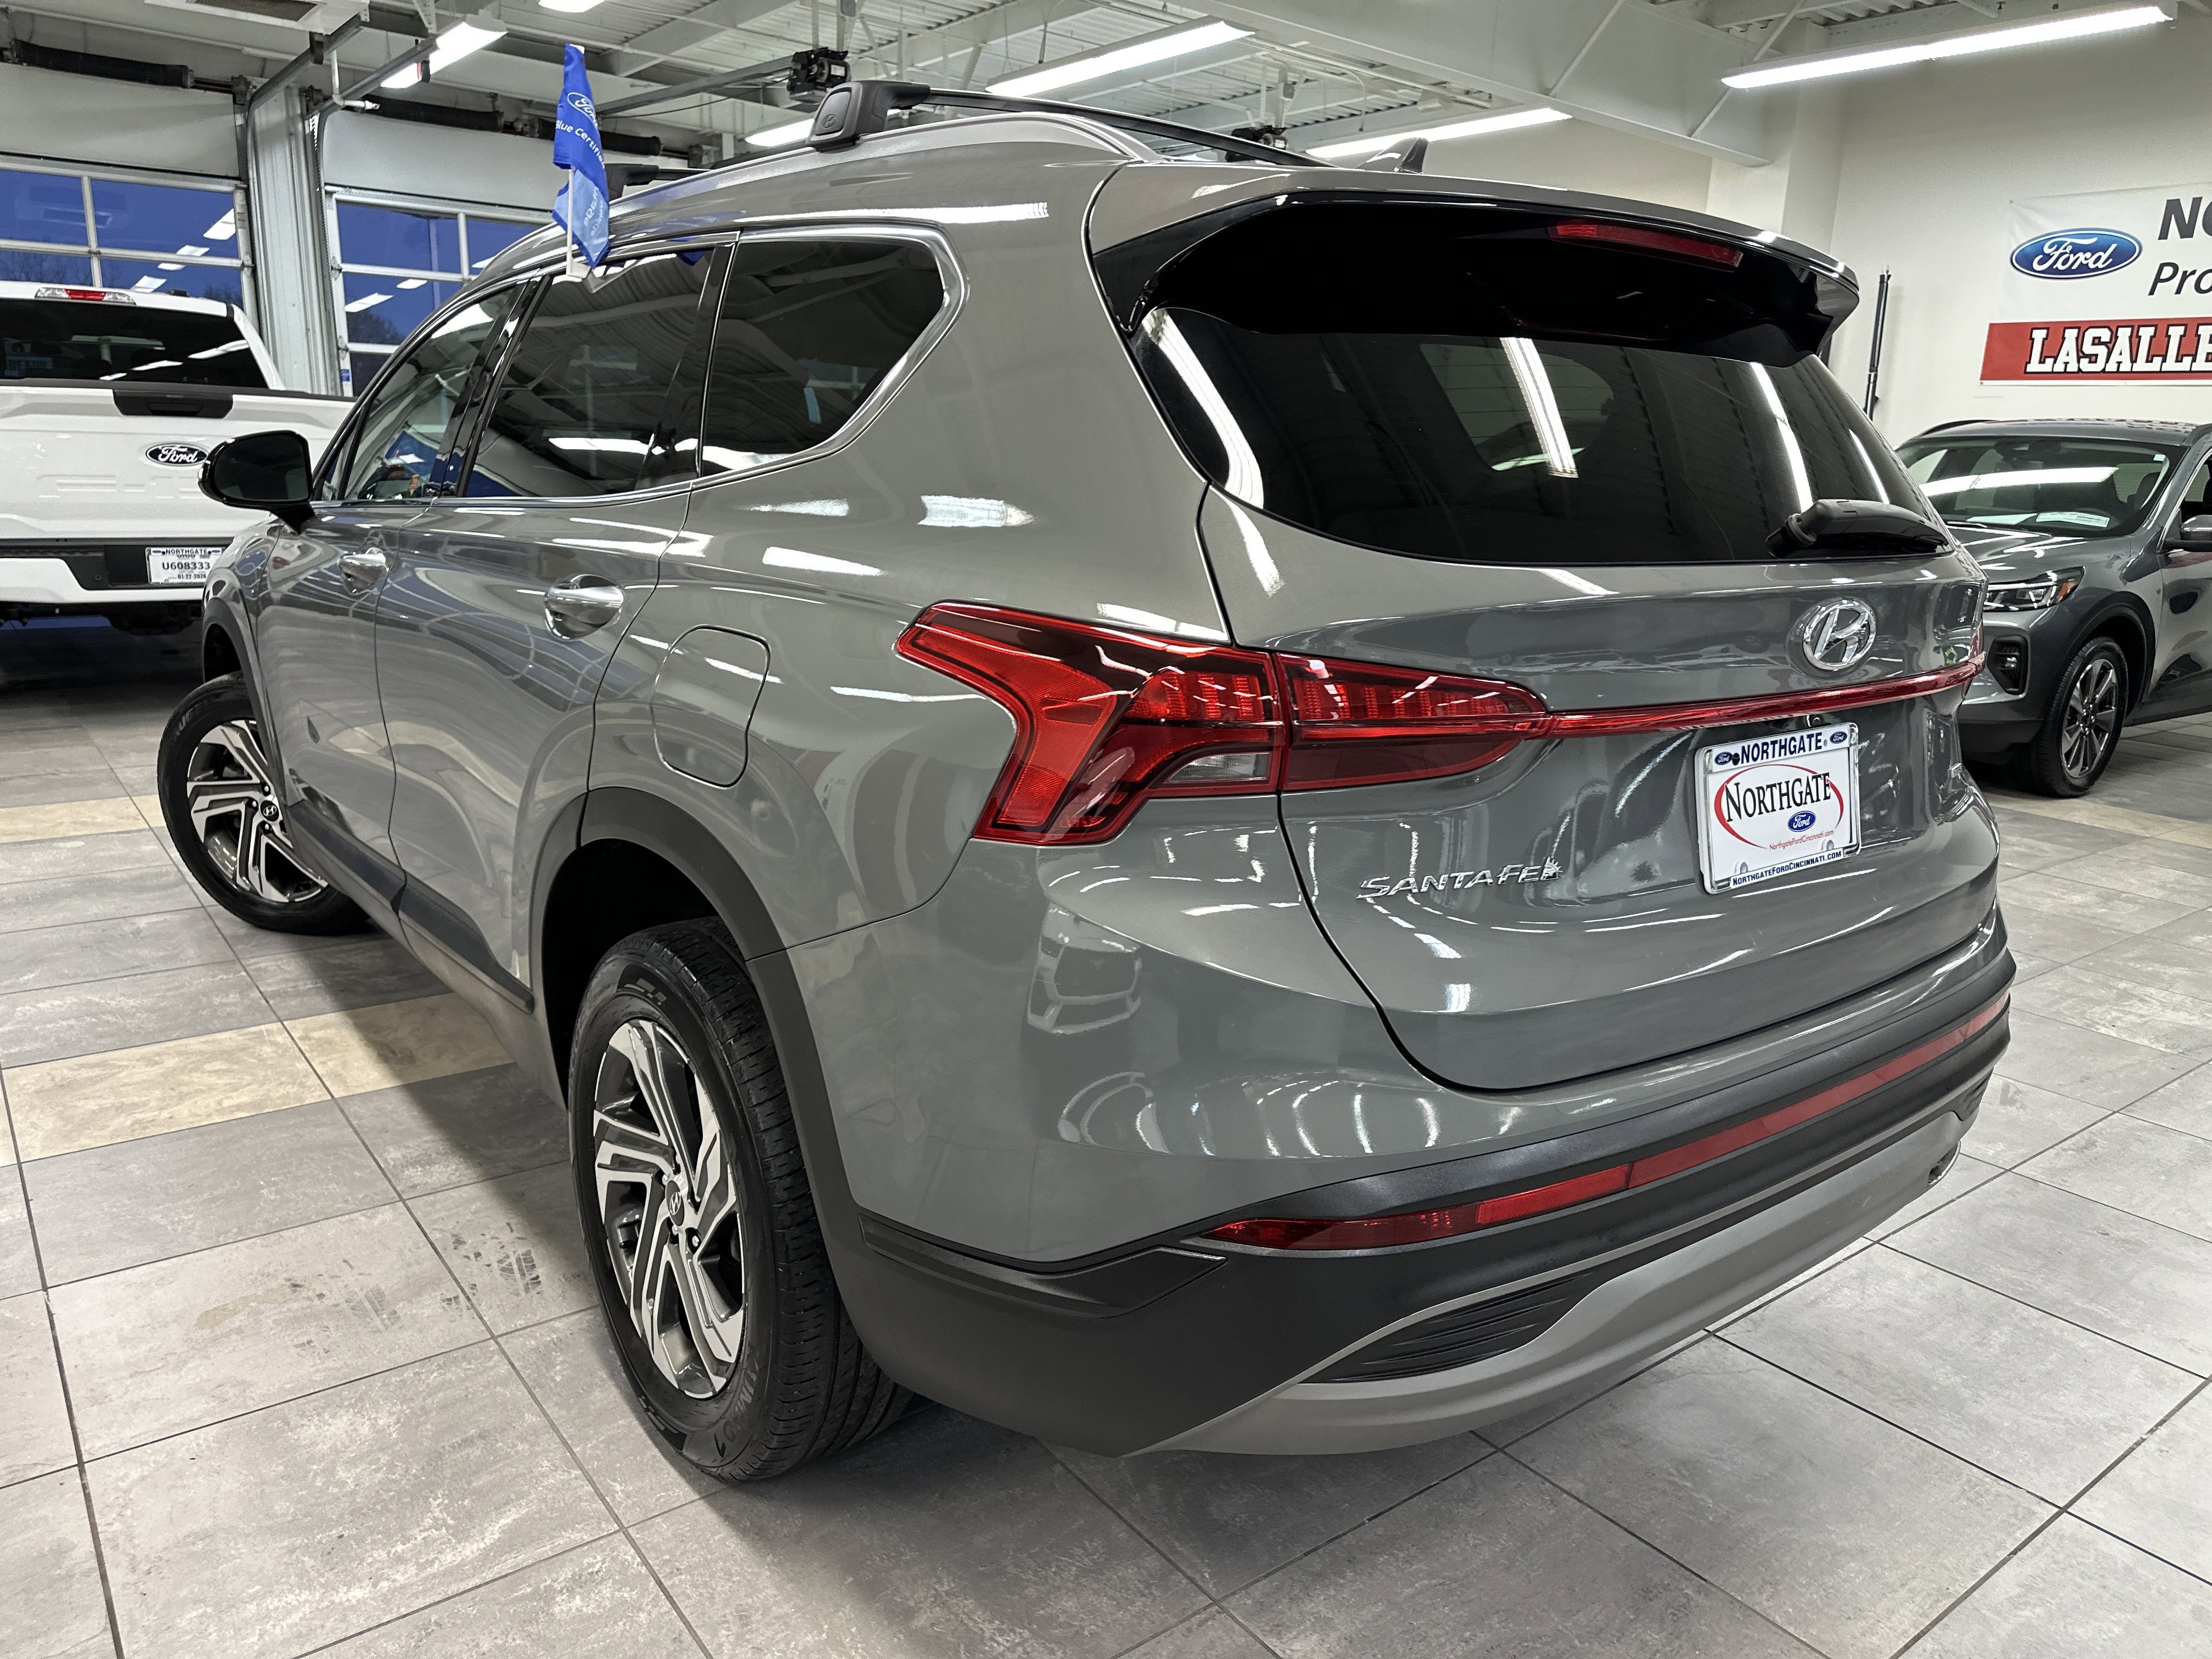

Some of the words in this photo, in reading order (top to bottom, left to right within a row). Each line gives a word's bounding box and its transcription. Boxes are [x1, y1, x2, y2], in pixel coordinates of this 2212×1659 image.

[2032, 236, 2118, 272] Ford
[2024, 323, 2212, 375] LASALLE
[158, 445, 199, 463] Ford
[162, 562, 210, 570] U608333
[1741, 732, 1822, 764] NORTHGATE
[1725, 772, 1831, 822] NORTHGATE
